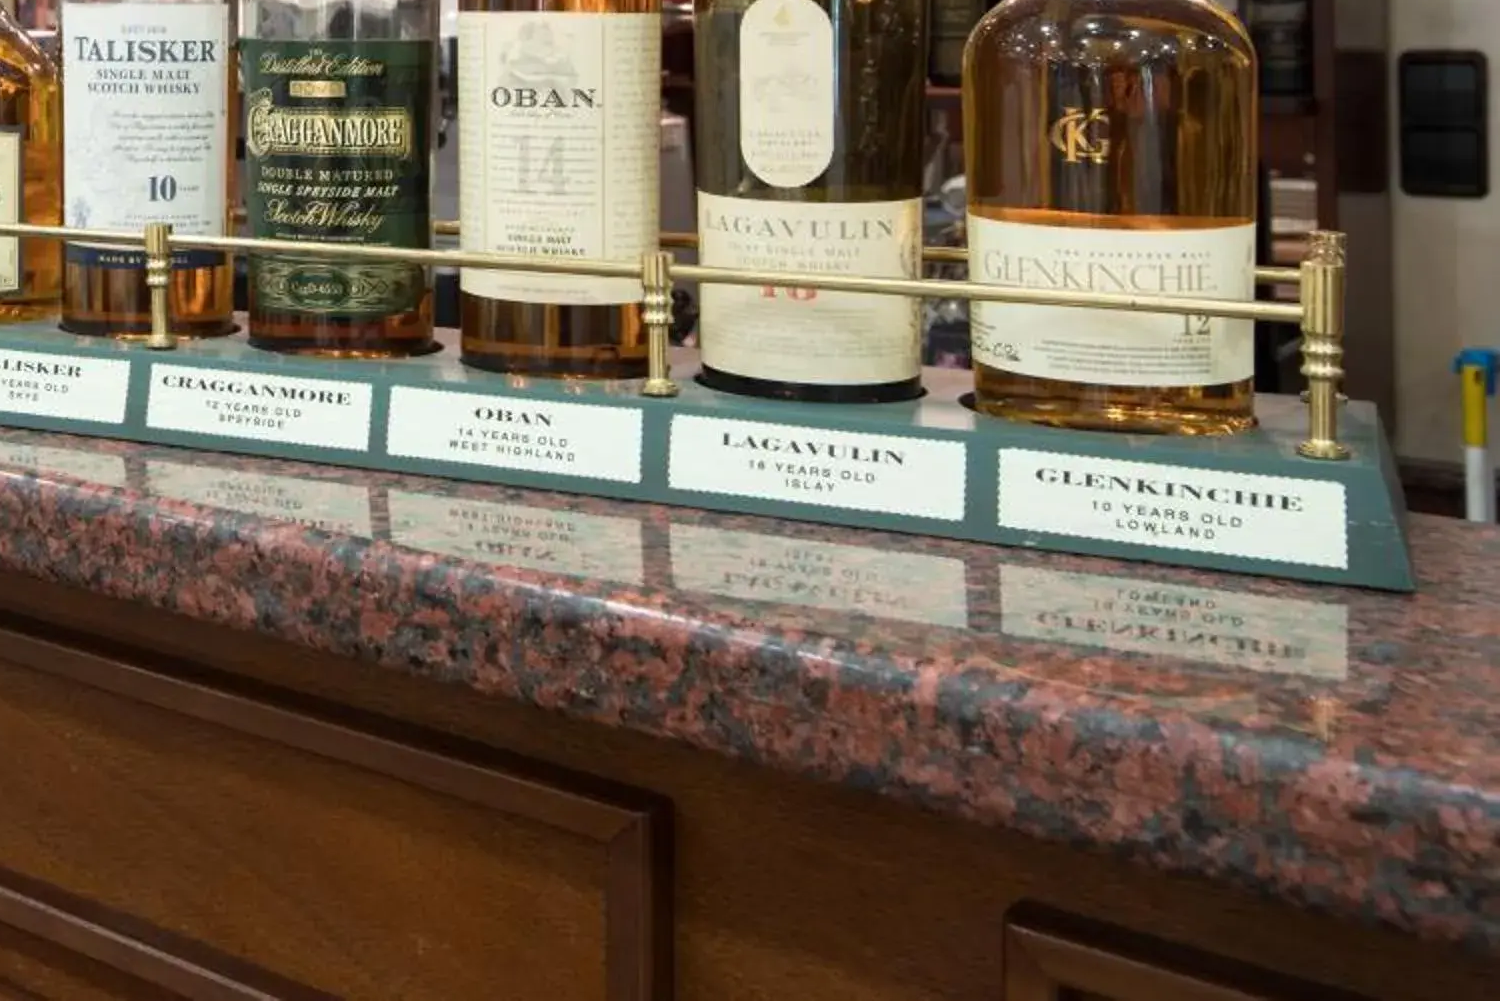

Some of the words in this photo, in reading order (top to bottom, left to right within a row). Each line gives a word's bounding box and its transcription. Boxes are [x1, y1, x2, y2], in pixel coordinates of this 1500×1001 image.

[74, 36, 216, 63] TALISKER
[97, 69, 148, 81] SINGLE
[152, 69, 191, 81] MALT
[88, 82, 140, 94] SCOTCH
[144, 82, 200, 95] WHISKY
[248, 101, 403, 153] CRAGGANMORE
[148, 174, 177, 202] 10
[706, 207, 894, 241] LAGAVULIN
[1, 377, 40, 390] YEARS
[43, 382, 70, 394] OLD
[162, 374, 352, 407] CRAGGANMORE
[225, 402, 270, 417] YEARS
[275, 407, 303, 419] OLD
[473, 406, 553, 428] OBAN
[458, 427, 474, 438] 14
[480, 430, 531, 445] YEARS
[537, 436, 569, 449] OLD
[722, 432, 906, 467] LAGAVULIN
[449, 439, 489, 452] WEST
[495, 445, 576, 463] HIGHLAND
[775, 462, 832, 479] YEARS
[840, 469, 876, 484] OLD
[784, 477, 836, 493] ISLAY
[1035, 467, 1304, 513] GLENKINCHIE
[1091, 499, 1112, 513] 10
[1123, 502, 1191, 523] YEARS
[1200, 513, 1244, 529] OLD
[1115, 518, 1217, 541] LOWLAND
